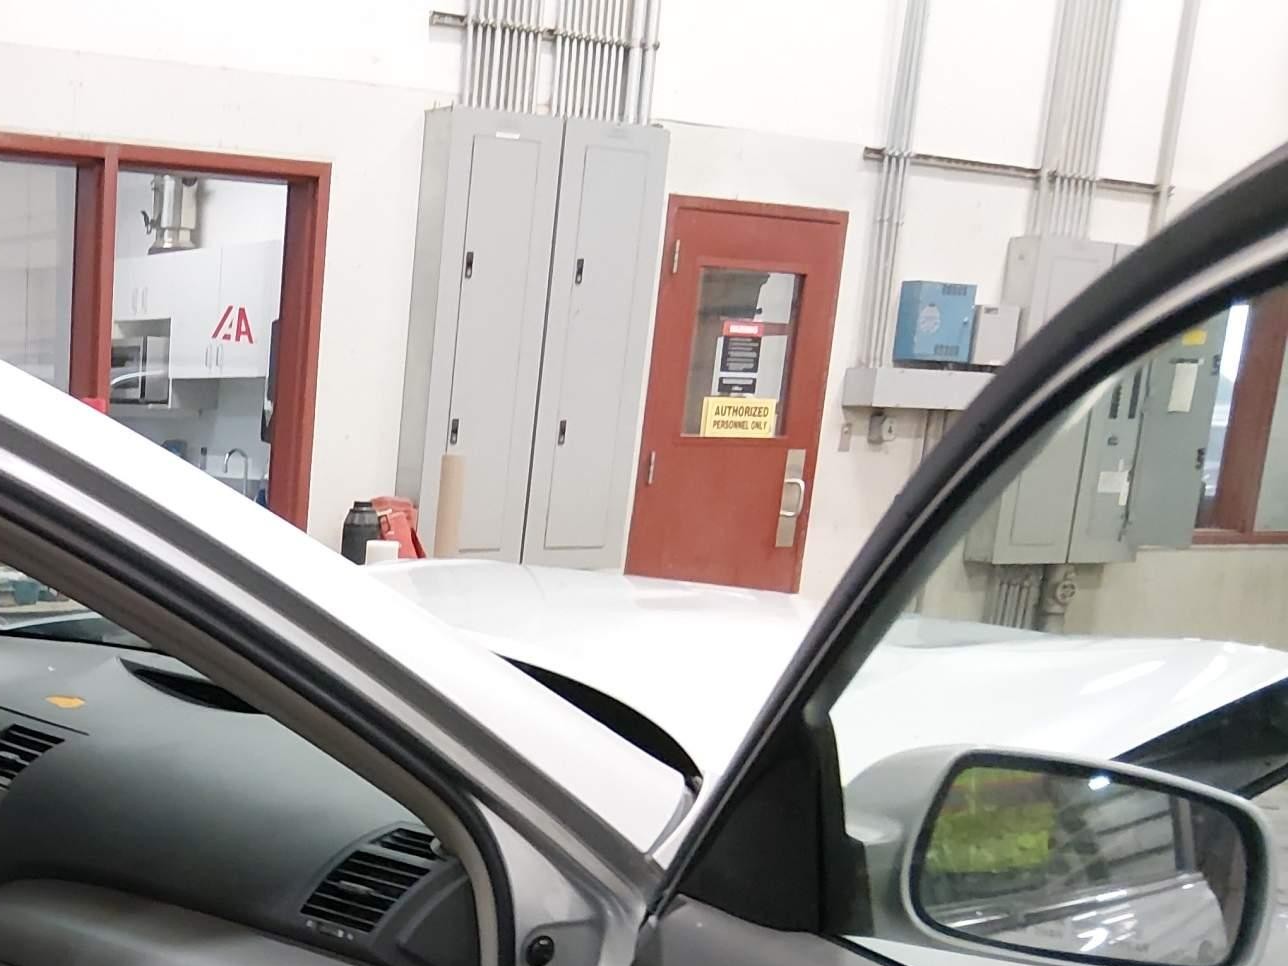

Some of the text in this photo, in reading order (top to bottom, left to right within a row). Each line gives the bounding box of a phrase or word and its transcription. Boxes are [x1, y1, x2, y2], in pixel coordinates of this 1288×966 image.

[714, 405, 770, 418] AUTHORIZED
[712, 419, 768, 431] PERSONNEL ONLY
